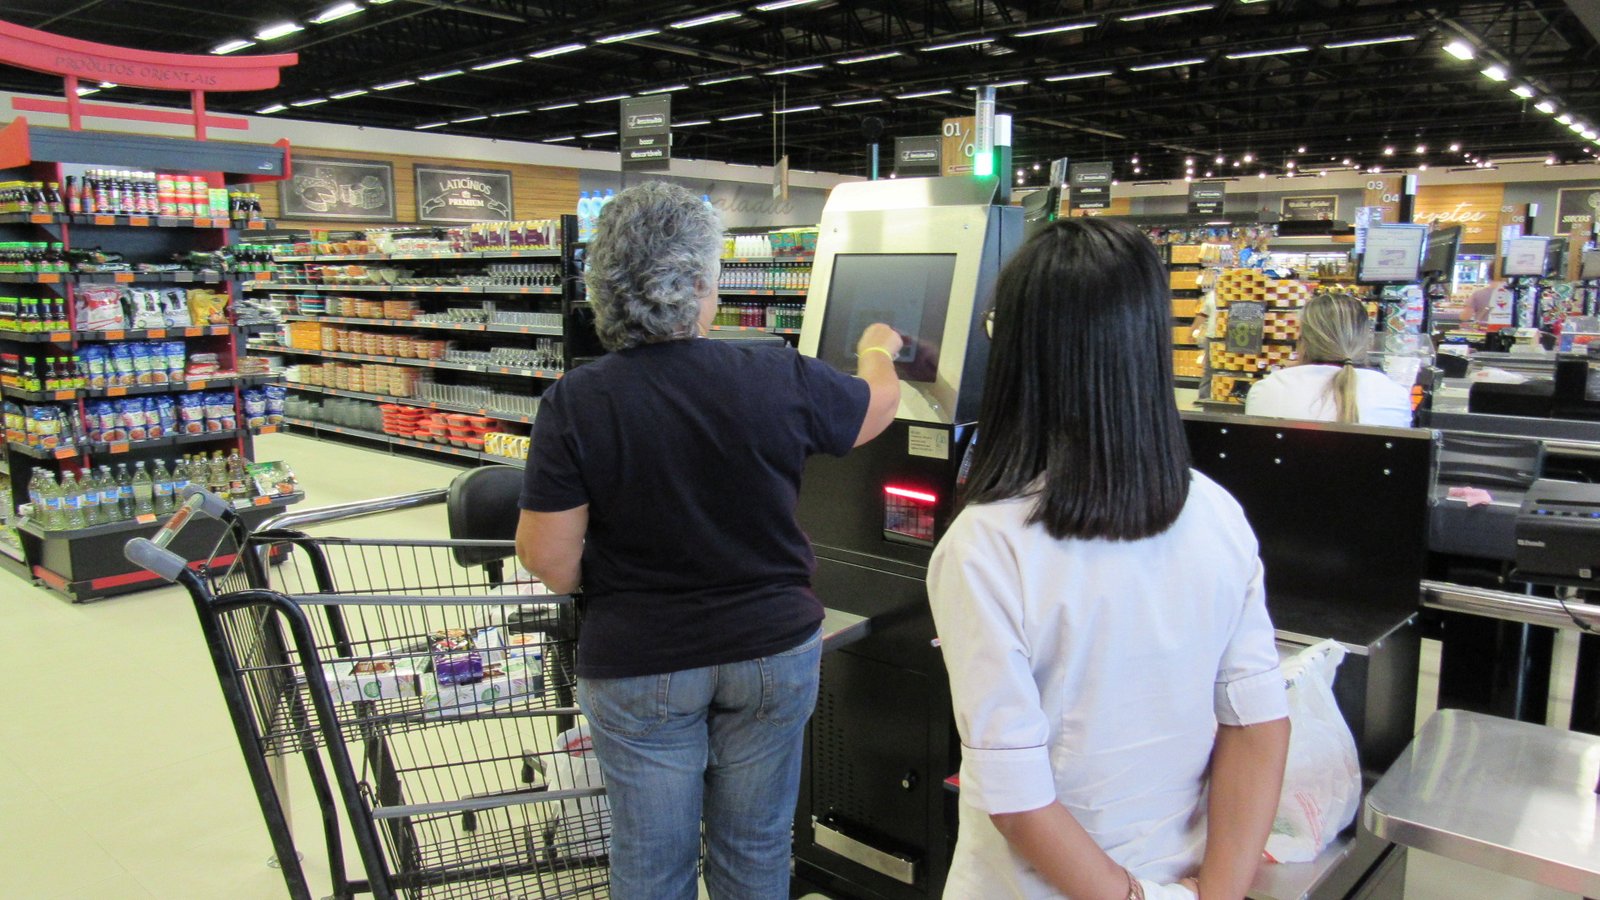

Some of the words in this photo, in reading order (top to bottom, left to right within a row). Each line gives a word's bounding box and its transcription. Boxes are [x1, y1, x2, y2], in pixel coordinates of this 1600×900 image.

[55, 56, 134, 76] PRODUTOS
[943, 123, 961, 137] 01
[964, 143, 979, 157] 0
[439, 177, 492, 195] LATICÍNIOS
[1366, 180, 1384, 190] 03
[448, 198, 485, 207] PREMIUM
[1382, 193, 1400, 203] 04
